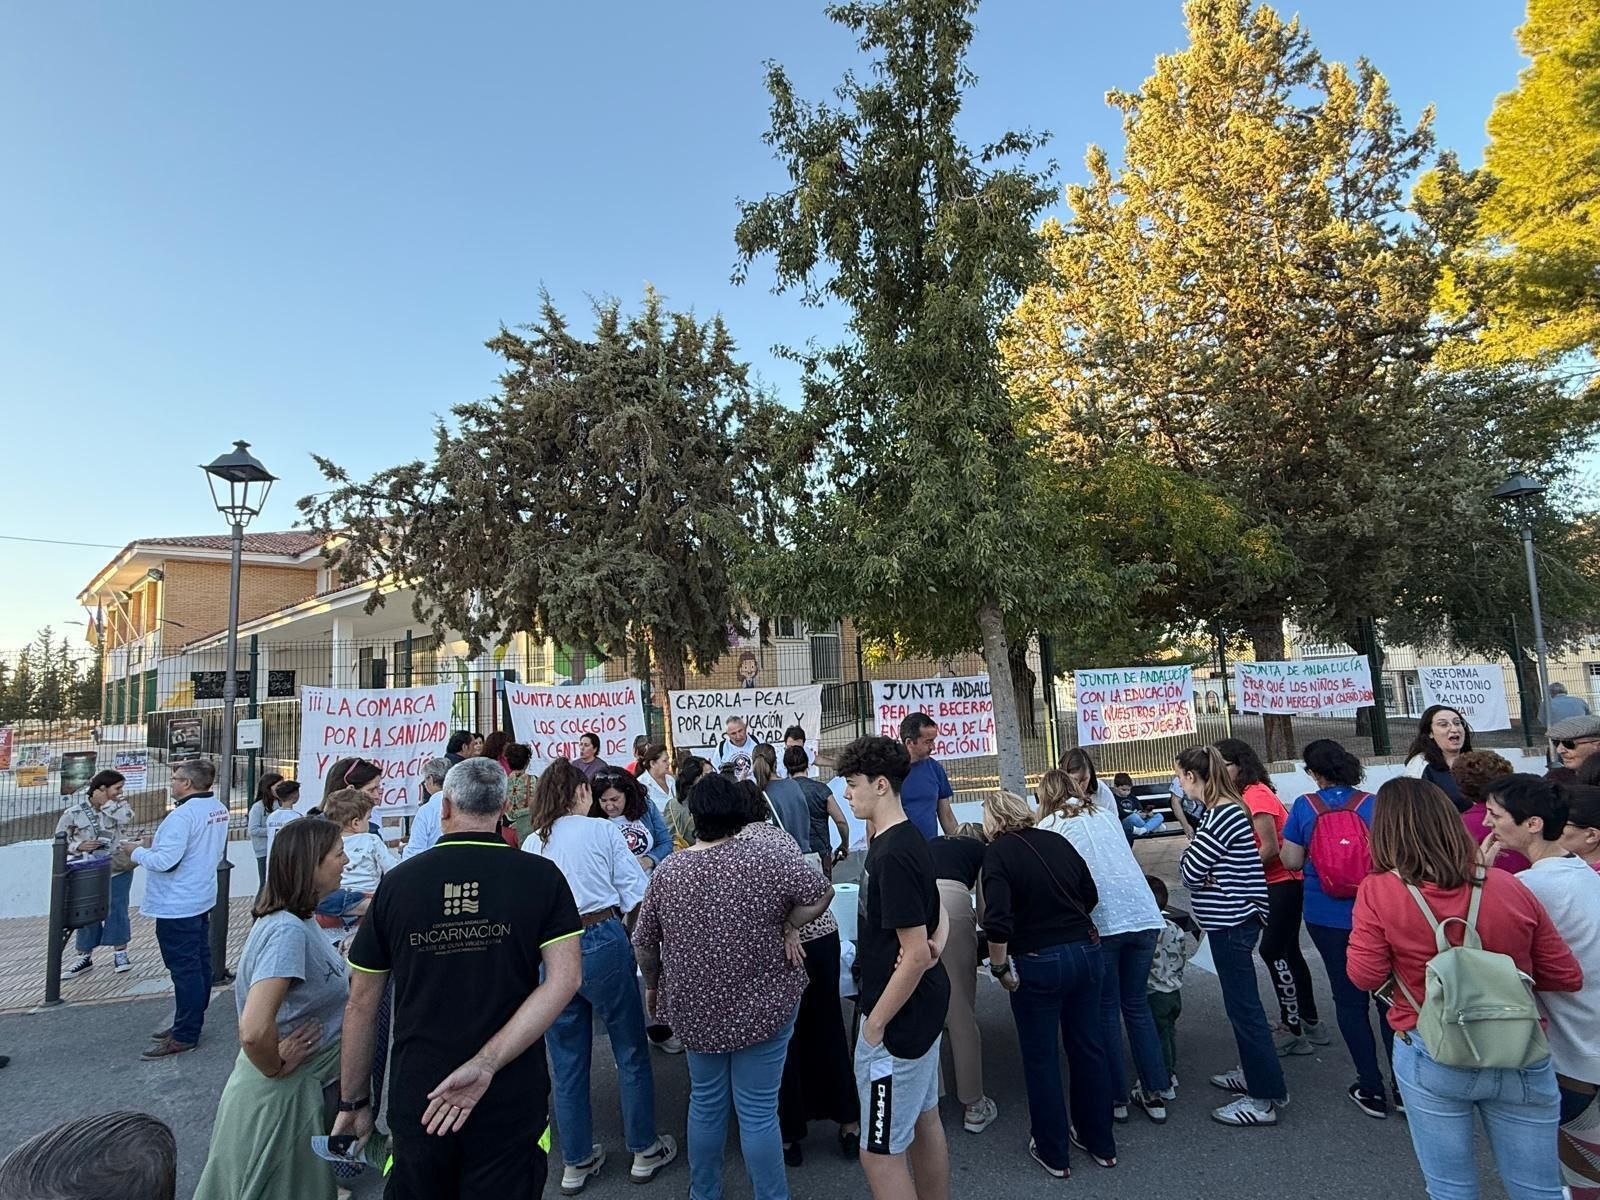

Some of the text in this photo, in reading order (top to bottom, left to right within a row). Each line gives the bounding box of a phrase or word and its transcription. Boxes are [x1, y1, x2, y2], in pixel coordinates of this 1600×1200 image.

[1243, 663, 1282, 677] JUNTA
[1287, 665, 1299, 676] DE
[1431, 667, 1480, 679] REFORMA
[1079, 672, 1120, 688] JUNTA
[1124, 671, 1137, 684] DE
[1266, 676, 1285, 694] QUÉ
[1290, 681, 1308, 693] LOS
[1342, 677, 1355, 689] DE
[1445, 680, 1491, 690] ANTONIO
[512, 689, 555, 707] JUNTA
[556, 694, 572, 709] DE
[882, 682, 945, 700] JUNTA
[1080, 681, 1185, 705] CON LA EDUCACIÓN
[326, 697, 352, 718] LA
[356, 693, 436, 717] COMARCA
[919, 703, 935, 718] DE
[939, 700, 993, 717] BECERRO
[1083, 699, 1189, 722] DE NUESTROS HIJOS
[1270, 695, 1284, 708] NO
[533, 711, 627, 735] LOS COLEGIOS
[677, 714, 702, 733] POR
[705, 714, 722, 731] LA
[962, 720, 977, 735] DE
[978, 717, 994, 735] LA
[1091, 726, 1112, 741] NO
[1118, 723, 1137, 739] SE
[324, 725, 356, 748] POR
[362, 726, 382, 748] LA
[702, 732, 718, 745] LA
[531, 739, 541, 759] Y
[606, 738, 627, 756] DE
[316, 752, 330, 780] Y
[1273, 959, 1300, 1025] adidas
